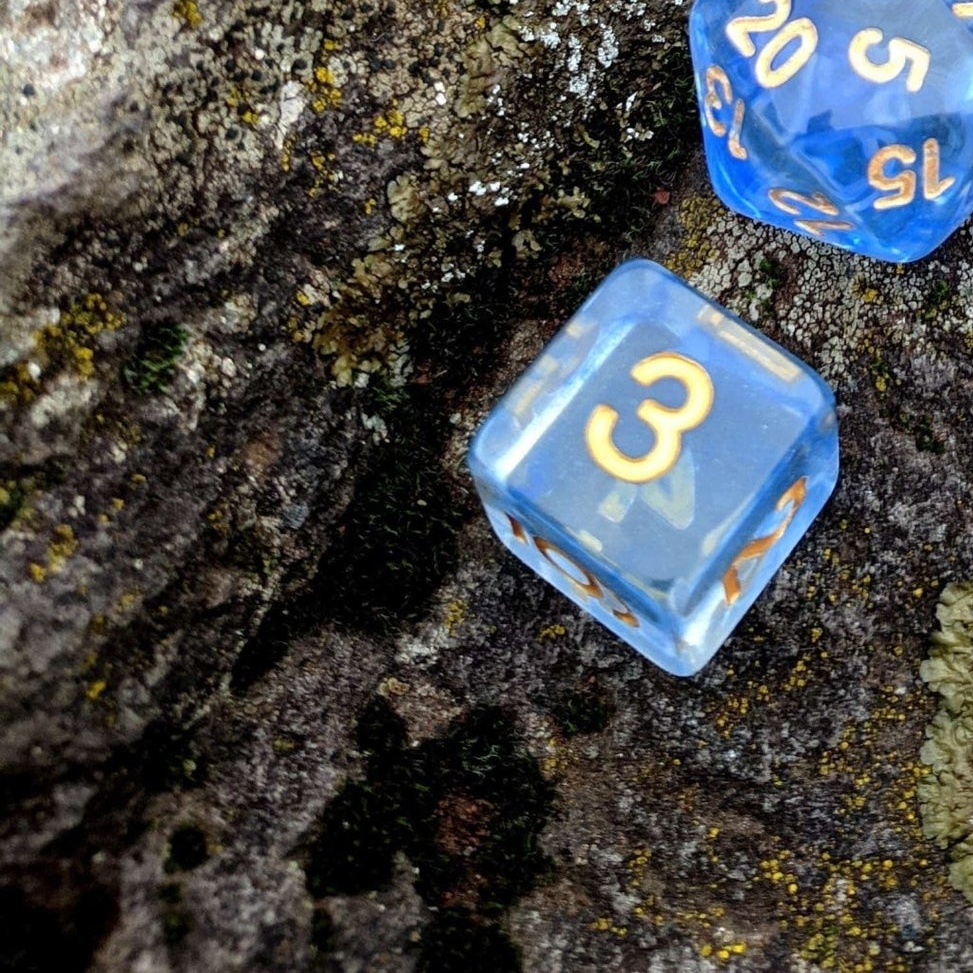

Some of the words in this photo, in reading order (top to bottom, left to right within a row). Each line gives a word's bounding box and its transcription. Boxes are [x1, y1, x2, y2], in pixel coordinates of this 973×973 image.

[849, 28, 931, 92] 5
[868, 138, 954, 210] 15
[585, 352, 715, 484] 3
